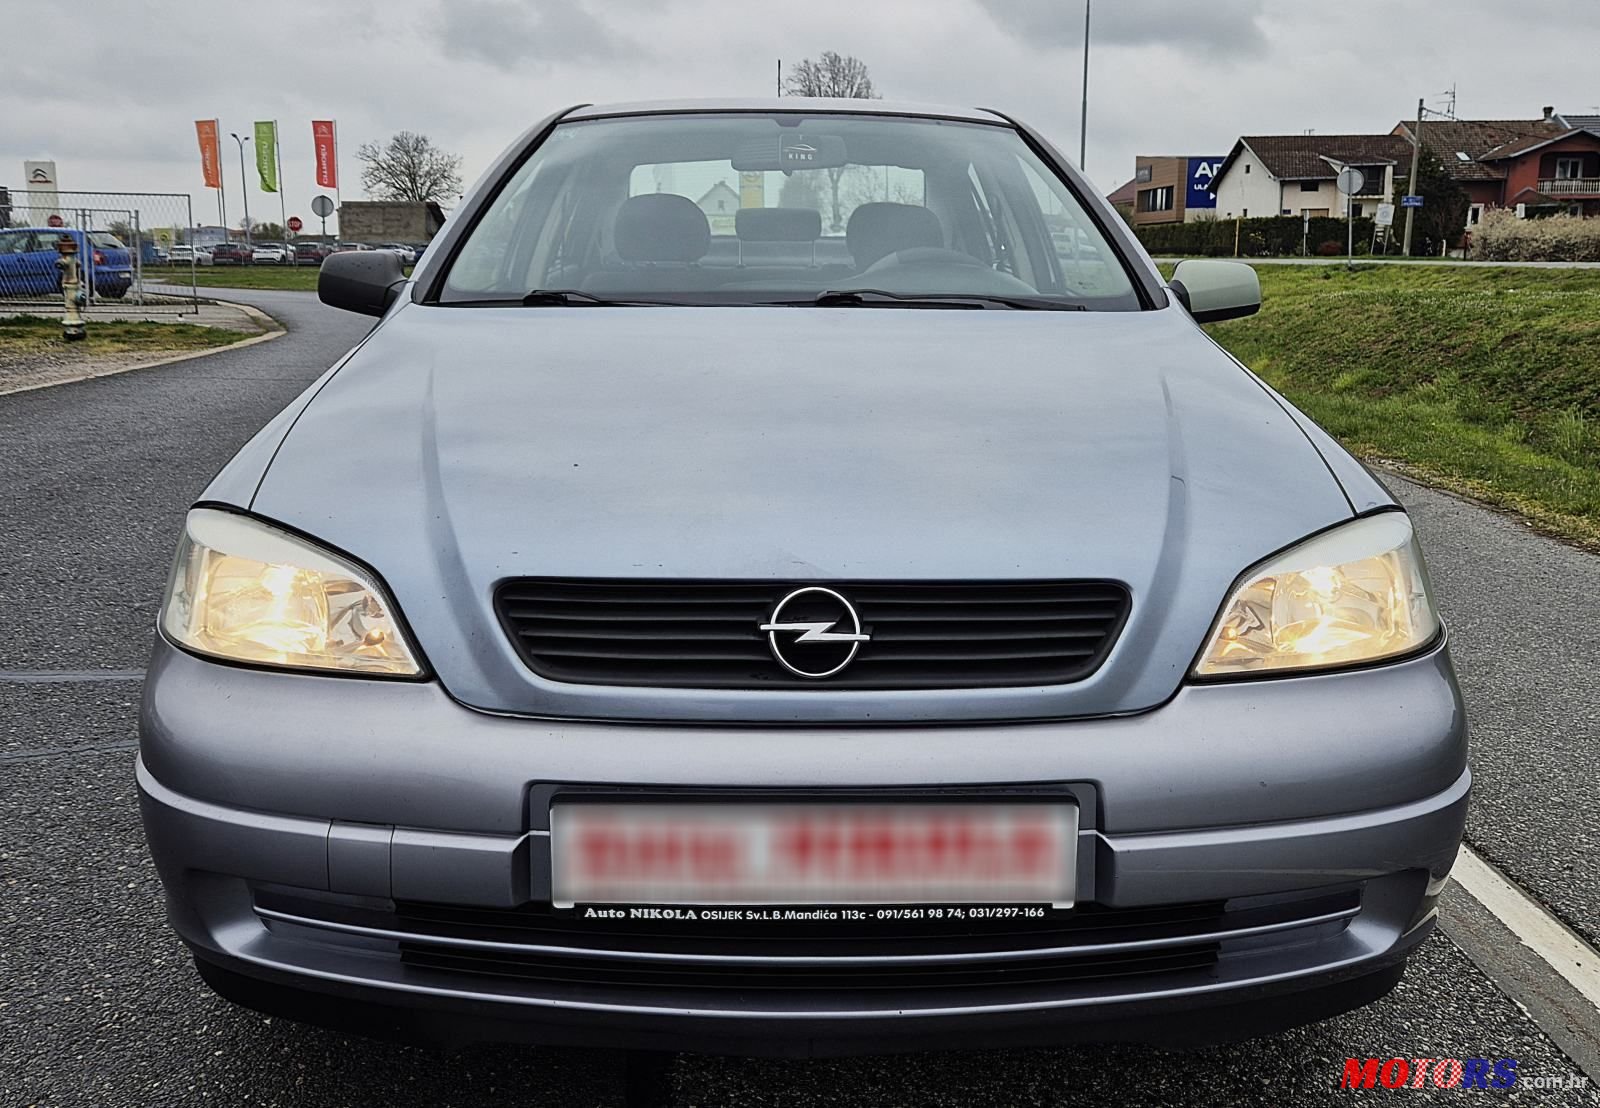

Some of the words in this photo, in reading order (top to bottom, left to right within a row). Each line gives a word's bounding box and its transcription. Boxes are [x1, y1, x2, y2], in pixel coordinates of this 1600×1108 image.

[584, 907, 626, 919] Auto
[629, 908, 698, 920] NIKOLA
[701, 910, 743, 920] OSIJEK
[841, 909, 867, 920] 113c
[876, 908, 924, 920] 091/561
[927, 908, 944, 919] 98
[946, 908, 966, 920] 74;
[968, 907, 1045, 919] 031/297-166
